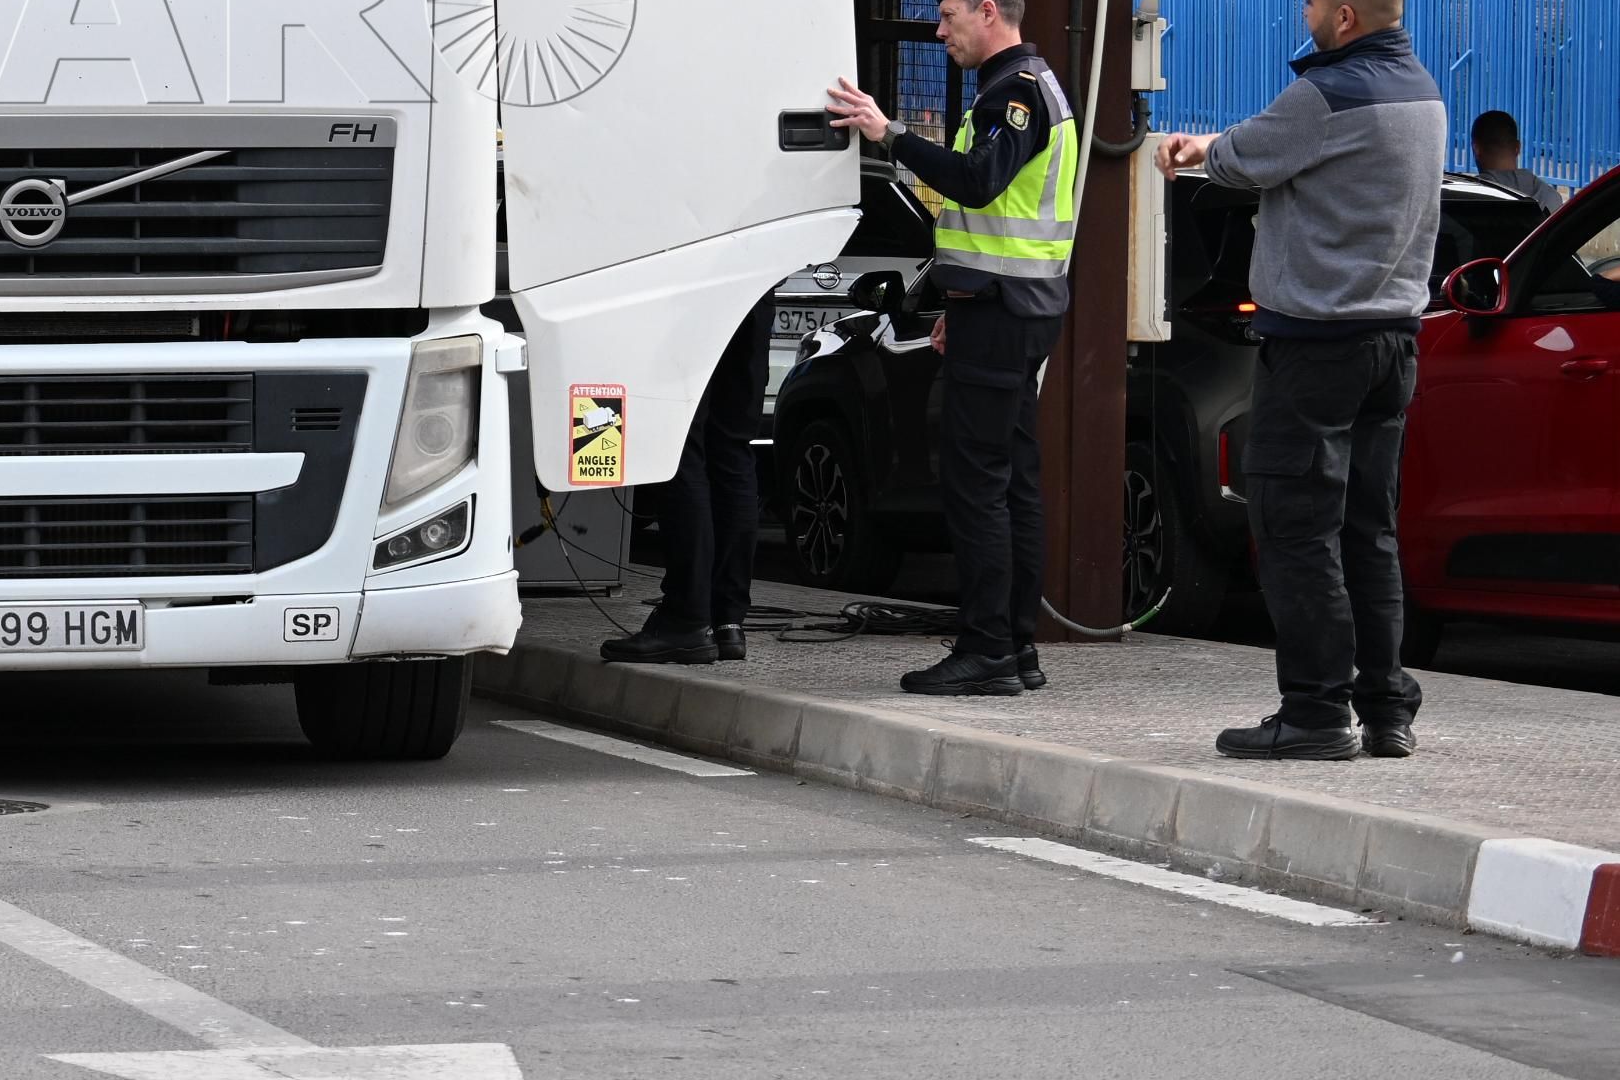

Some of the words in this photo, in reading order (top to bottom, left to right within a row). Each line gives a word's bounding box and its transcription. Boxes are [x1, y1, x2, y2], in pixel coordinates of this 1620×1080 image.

[328, 123, 378, 143] FH
[3, 208, 63, 217] VOLVO
[573, 386, 623, 396] ATTENTION
[577, 455, 617, 466] ANGLES
[579, 466, 615, 477] MORTS
[64, 610, 138, 645] HGM
[292, 613, 332, 636] SP
